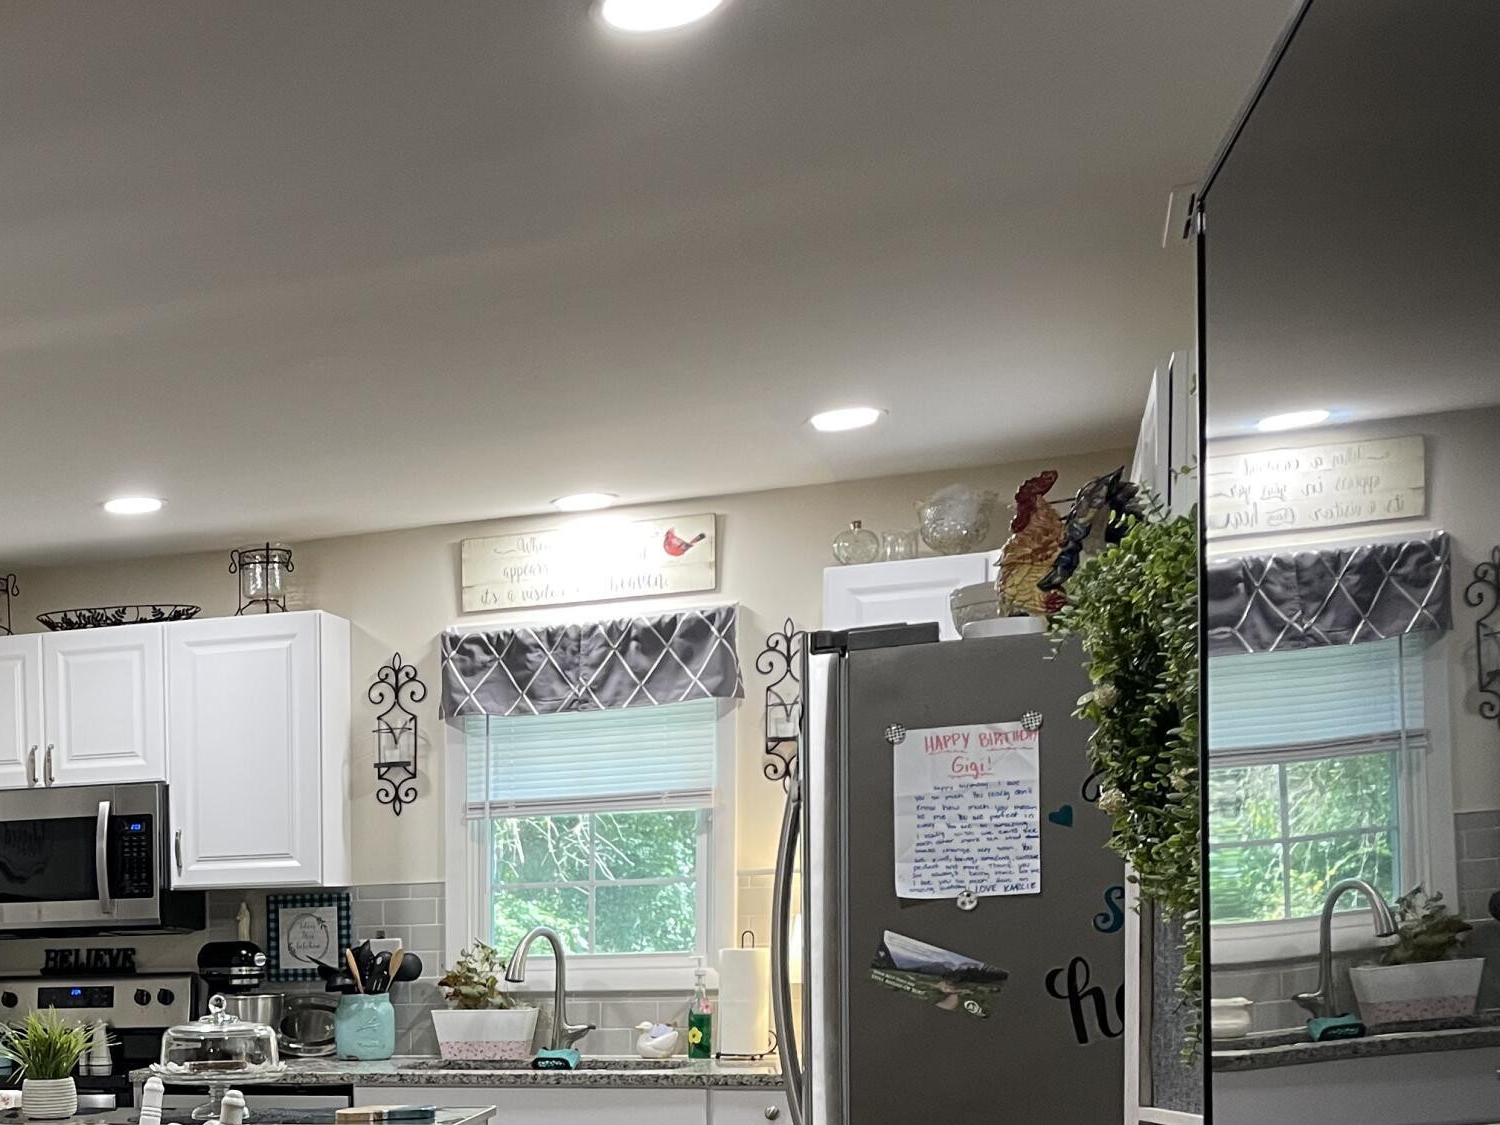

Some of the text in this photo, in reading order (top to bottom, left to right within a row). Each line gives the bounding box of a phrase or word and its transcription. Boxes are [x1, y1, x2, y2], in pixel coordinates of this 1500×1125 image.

[924, 732, 970, 753] HAPPY
[951, 756, 993, 779] Gigi!
[44, 948, 136, 971] BELIEVE
